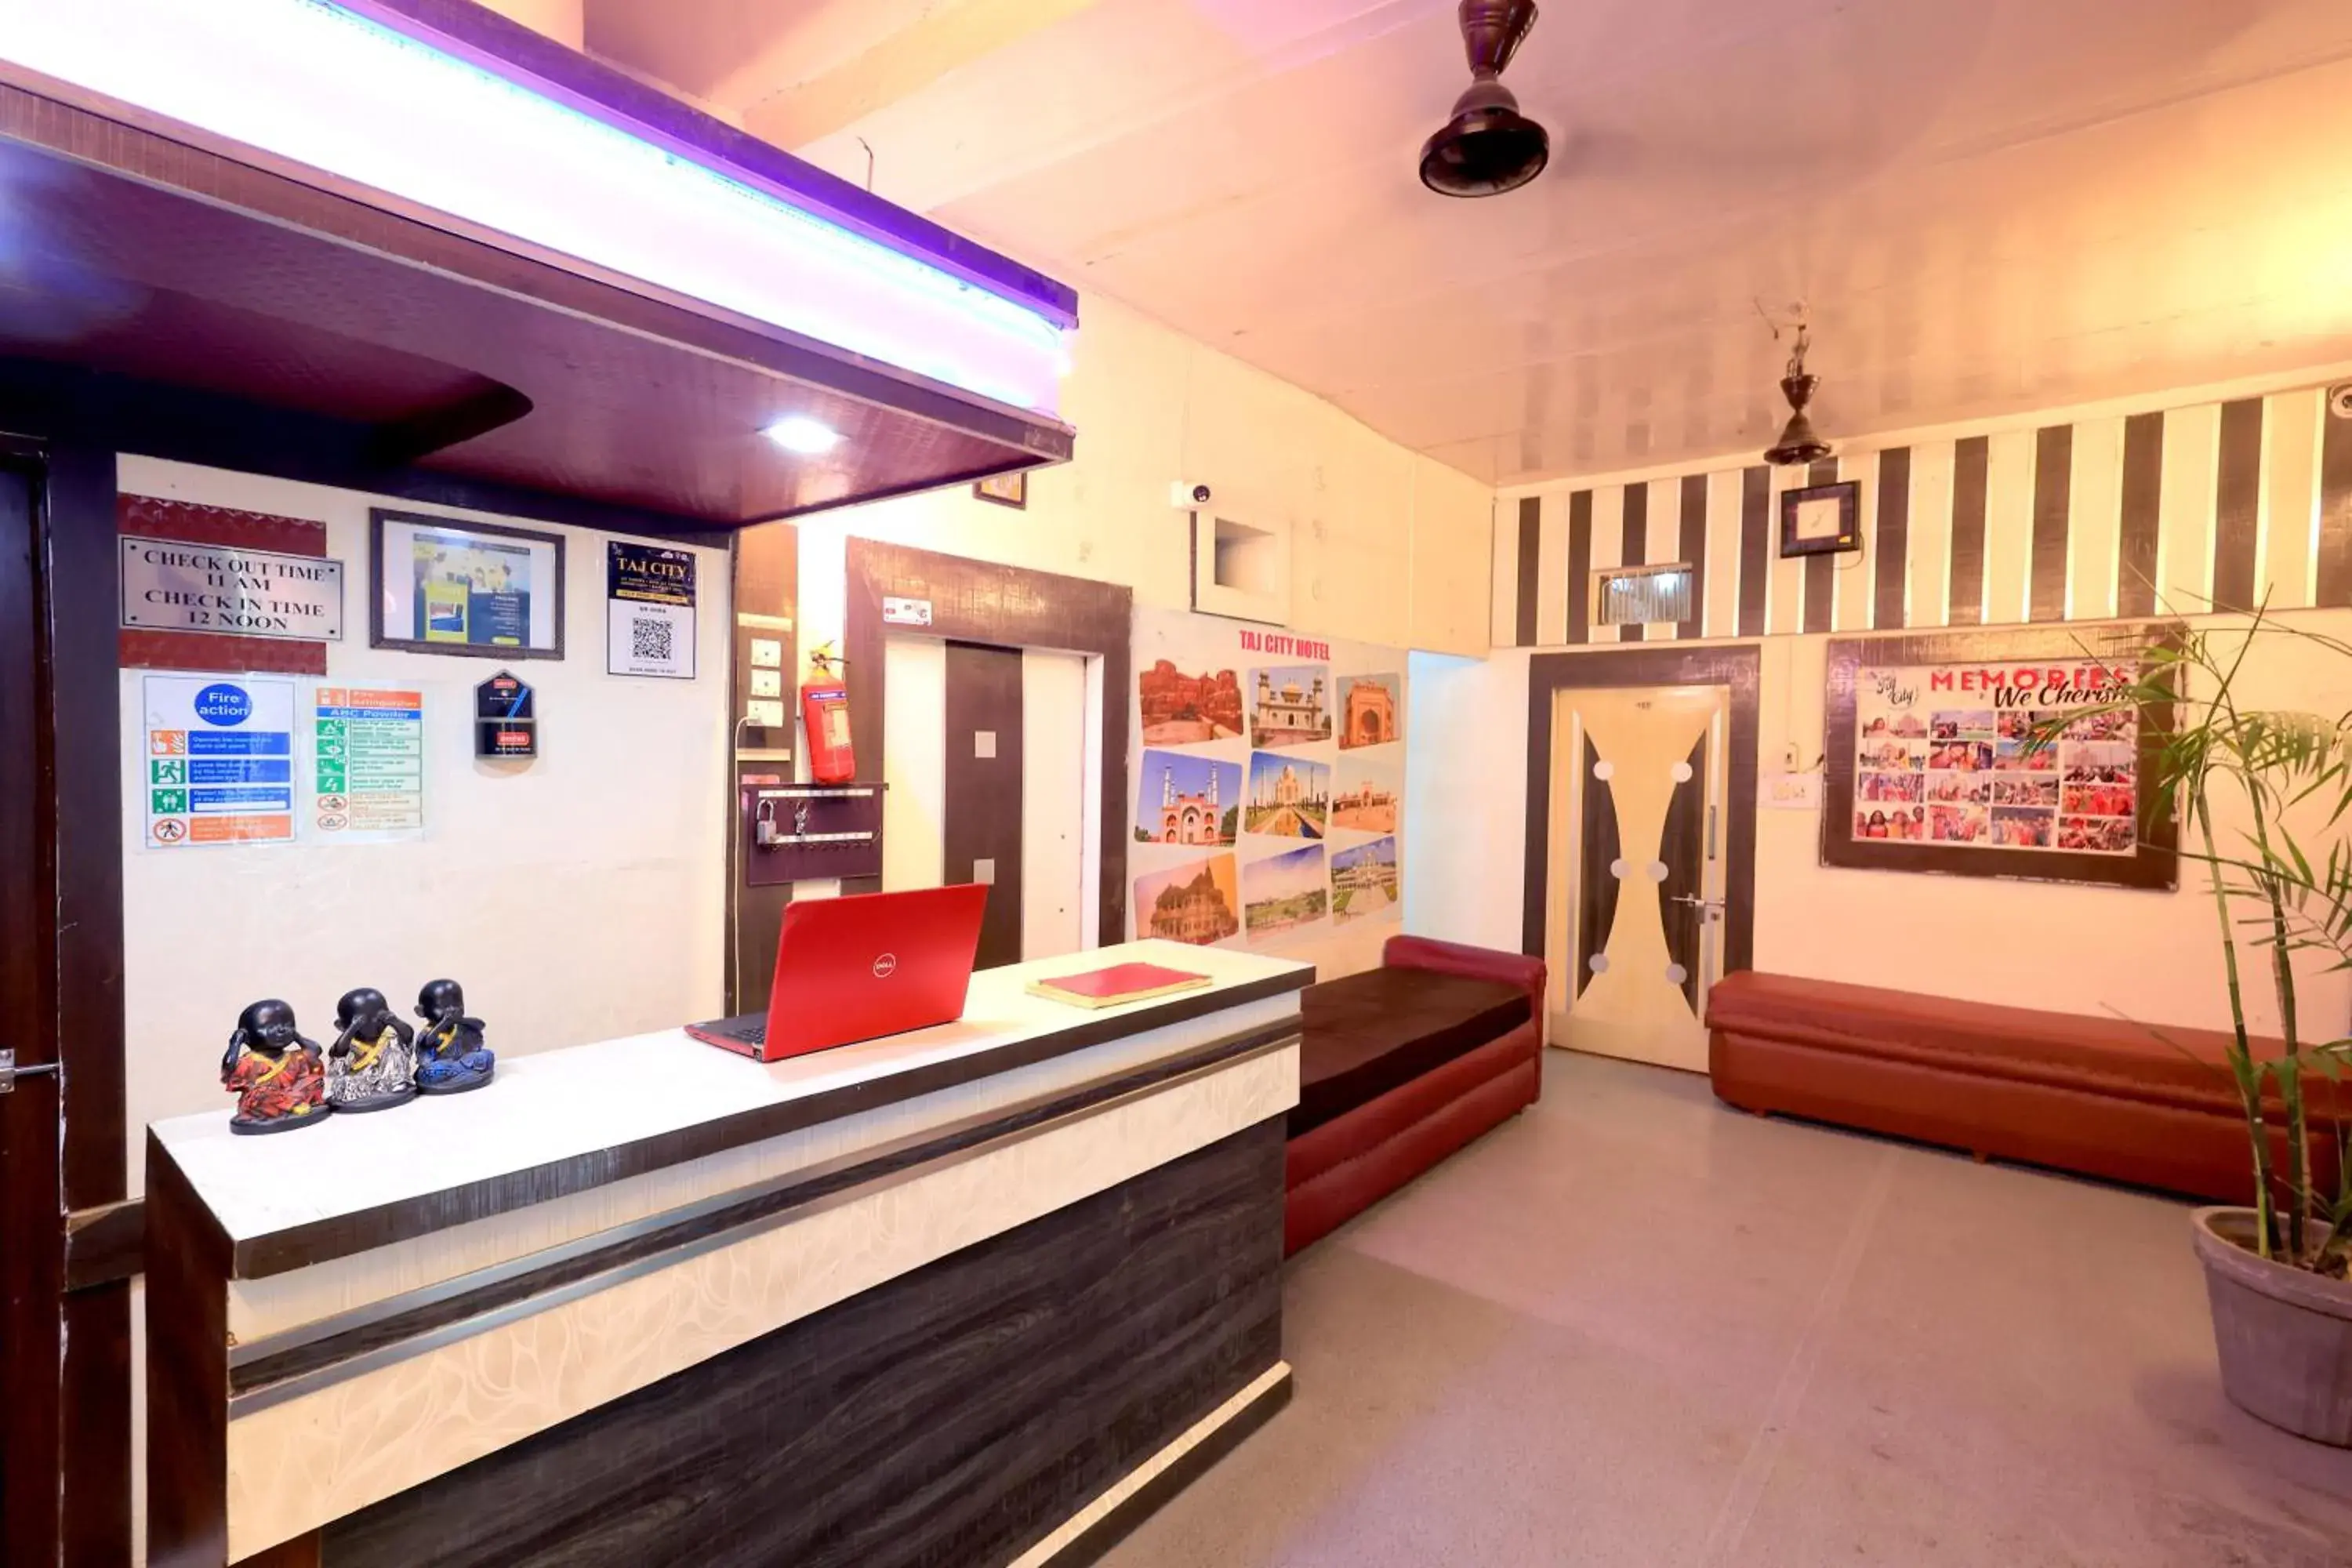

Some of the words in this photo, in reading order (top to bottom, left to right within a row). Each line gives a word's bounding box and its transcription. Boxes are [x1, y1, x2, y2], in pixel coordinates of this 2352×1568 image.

[144, 550, 220, 571] CHECK
[228, 559, 269, 575] OUT
[275, 563, 325, 582] TIME
[616, 557, 647, 572] TAJ
[650, 562, 687, 578] CITY
[208, 573, 223, 587] 11
[233, 577, 270, 592] AM
[145, 590, 230, 609] CHECK
[240, 598, 261, 611] IN
[269, 600, 325, 617] TIME
[190, 612, 209, 624] 12
[219, 613, 288, 630] NOON
[1240, 630, 1261, 651] TAJ
[1265, 634, 1294, 655] CITY
[1297, 639, 1330, 660] HOTEL
[1930, 666, 2130, 691] MEMORIES
[209, 692, 240, 704] Fire
[1994, 686, 2032, 707] We
[199, 706, 248, 716] action
[363, 710, 410, 719] Powder
